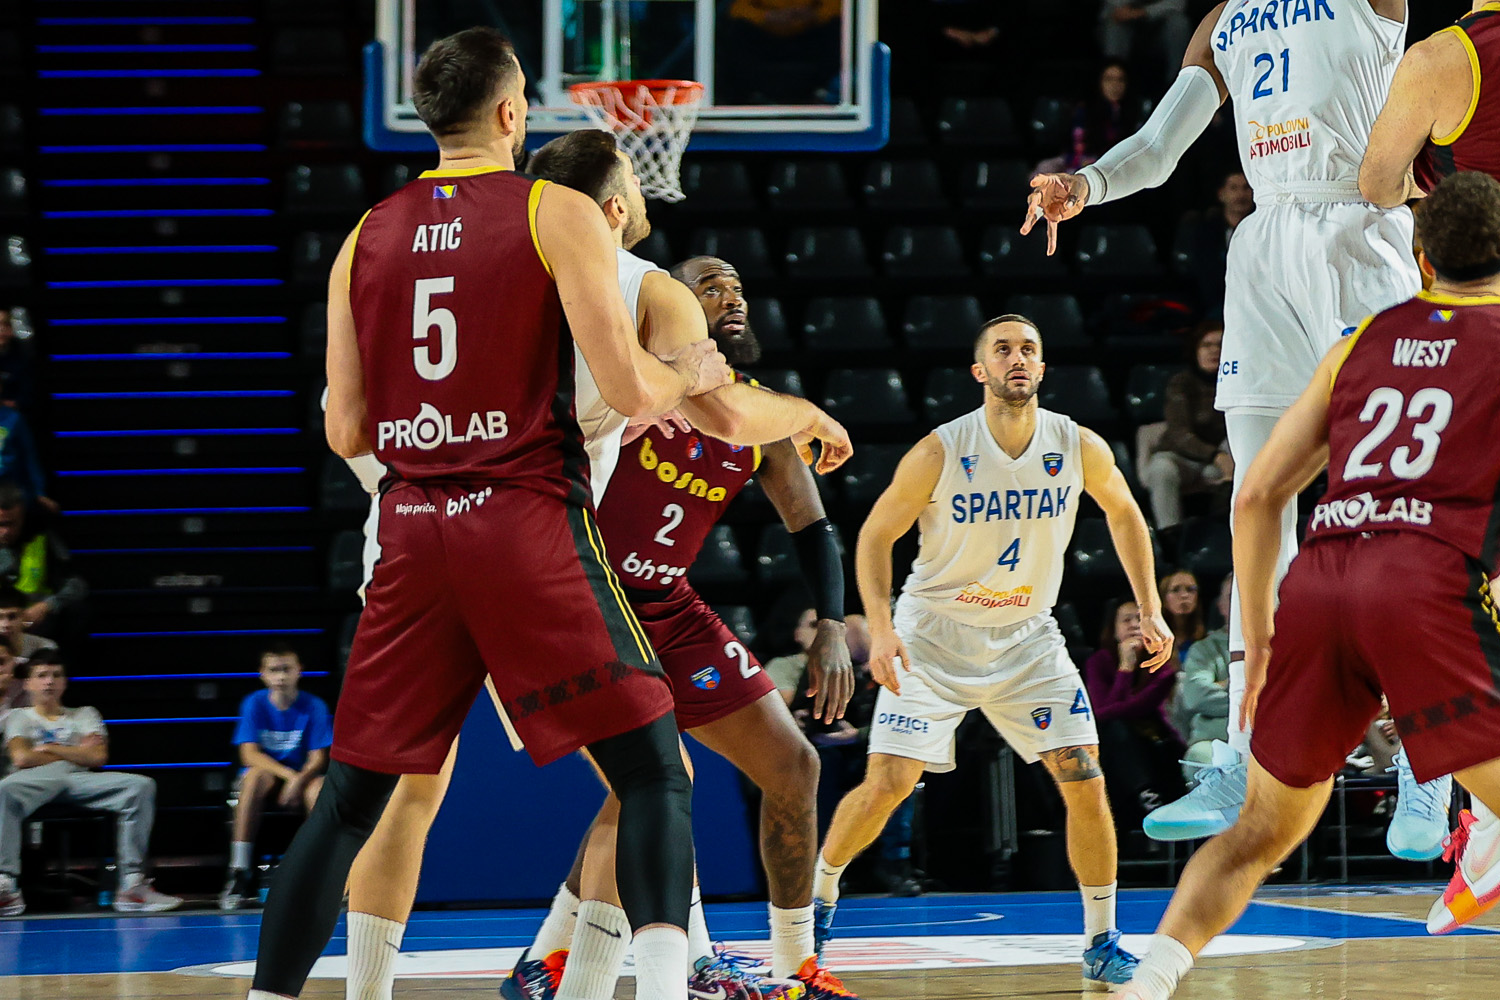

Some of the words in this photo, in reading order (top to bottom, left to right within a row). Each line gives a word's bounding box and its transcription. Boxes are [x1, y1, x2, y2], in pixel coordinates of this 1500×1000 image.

[1252, 48, 1290, 100] 21
[1267, 117, 1309, 137] POLOVNI
[412, 217, 463, 253] ATIĆ
[412, 276, 458, 381] 5
[1392, 338, 1457, 367] WEST
[378, 402, 509, 450] PROLAB
[1342, 386, 1454, 482] 23
[638, 437, 728, 502] bosna
[952, 485, 1072, 524] SPARTAK
[1311, 492, 1434, 532] PROLAB
[653, 503, 685, 546] 2
[997, 537, 1021, 572] 4
[723, 640, 762, 679] 2
[878, 712, 929, 734] OFFICE
[1069, 687, 1091, 722] 4
